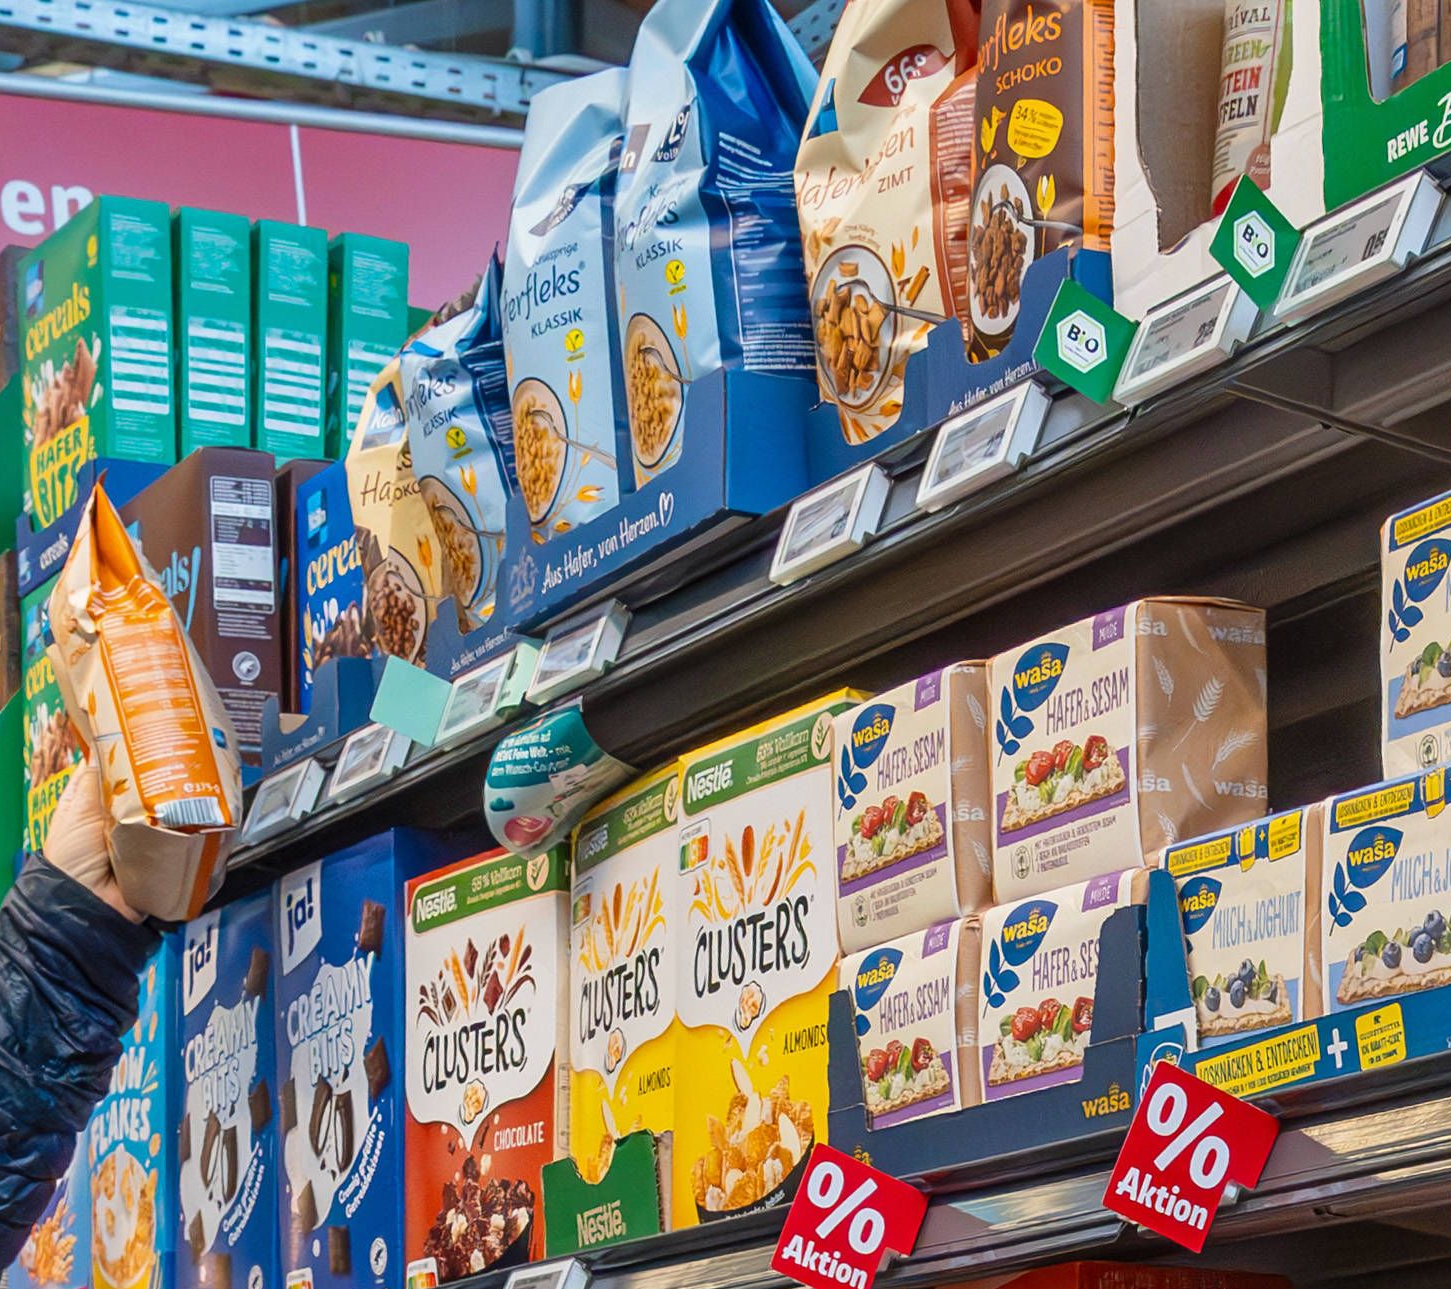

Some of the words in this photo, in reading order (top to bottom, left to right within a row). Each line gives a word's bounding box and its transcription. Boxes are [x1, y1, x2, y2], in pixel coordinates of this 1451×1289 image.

[995, 55, 1063, 94] SCHOKO
[1388, 122, 1429, 162] REWE
[877, 166, 914, 194] ZIMT
[24, 283, 91, 355] cereals
[530, 308, 583, 341] KLASSIK
[542, 560, 564, 594] Aus
[564, 541, 598, 580] Hafer,
[600, 538, 617, 566] von
[619, 512, 659, 559] Herzen.
[1096, 624, 1118, 644] MILDE
[1046, 694, 1085, 737] HAFER
[1091, 667, 1130, 712] SESAM
[686, 760, 733, 800] Nestlé
[284, 878, 314, 938] ja!
[415, 893, 457, 919] Nestlé
[1212, 908, 1249, 950] MILCH
[1255, 890, 1301, 939] JOGHURT
[286, 953, 373, 1042] CREAMY
[783, 1023, 829, 1056] ALMONDS
[493, 1120, 545, 1152] CHOCOLATE
